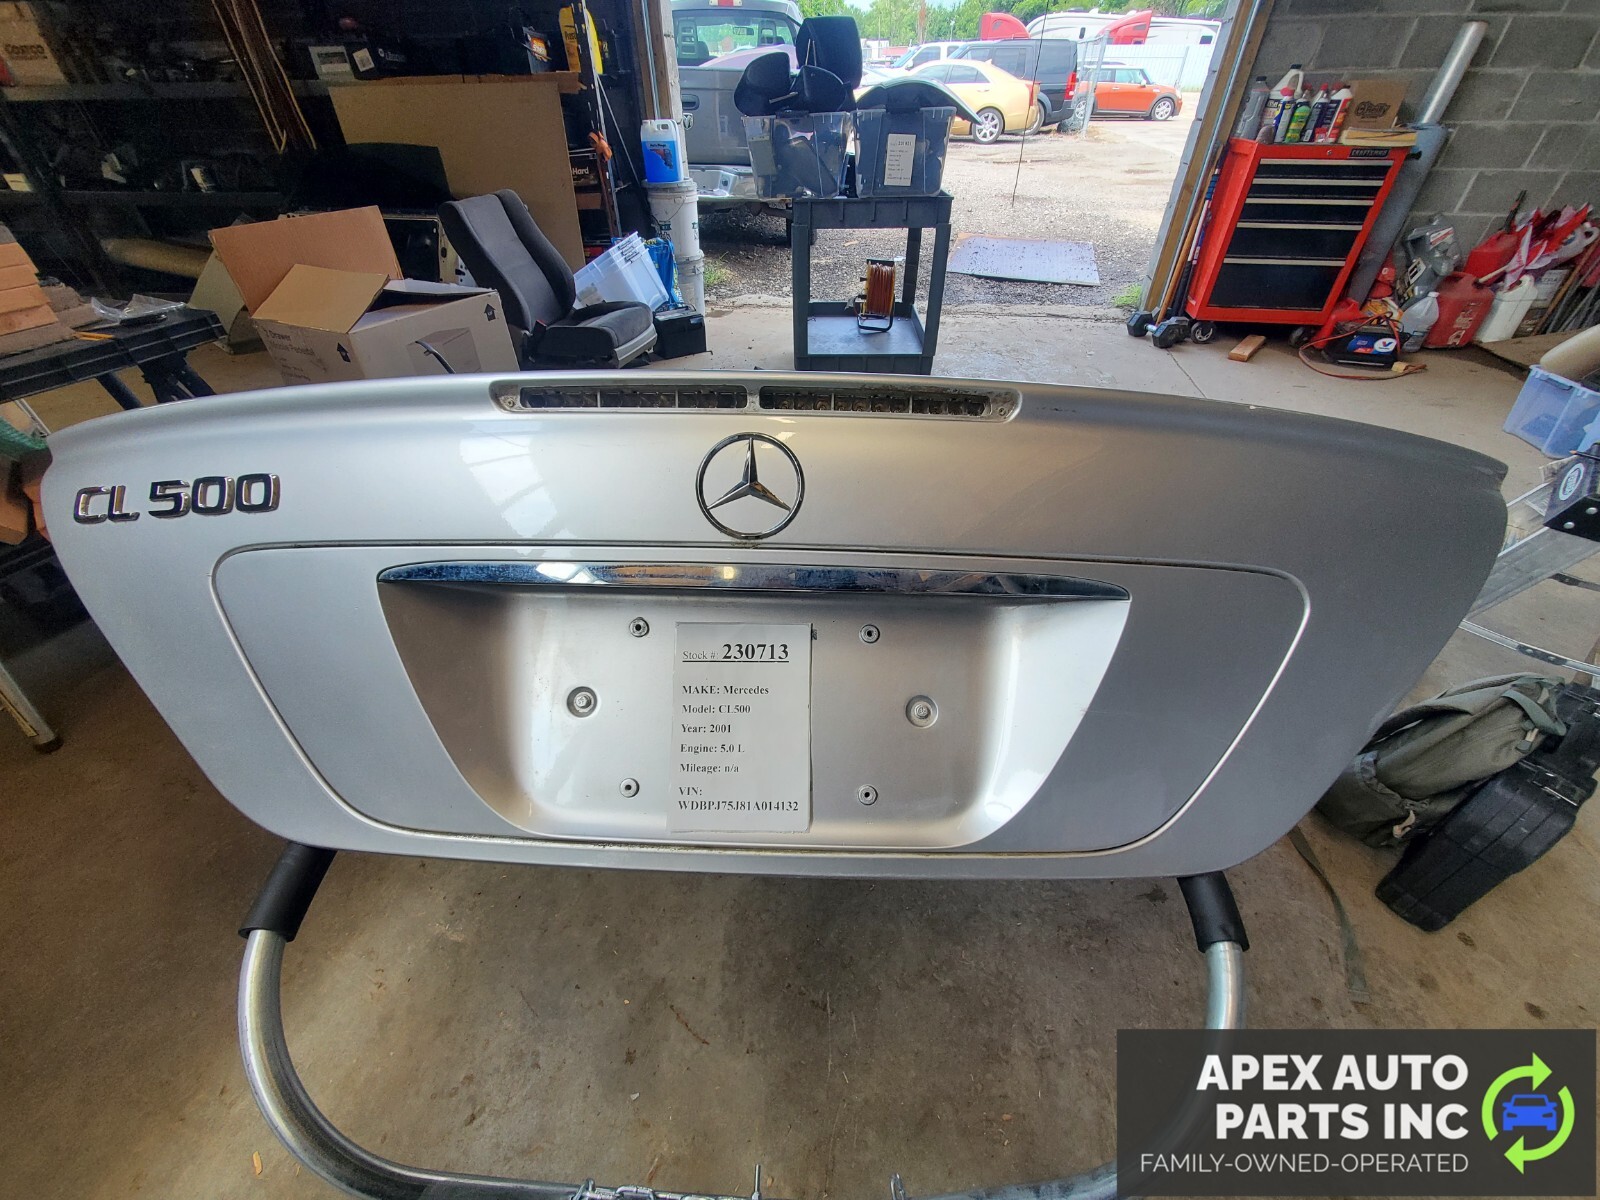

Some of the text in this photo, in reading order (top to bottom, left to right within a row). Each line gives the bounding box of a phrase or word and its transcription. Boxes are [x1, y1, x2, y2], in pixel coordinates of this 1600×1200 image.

[571, 166, 590, 176] Hard
[73, 473, 281, 525] CL 500
[682, 650, 708, 660] Stock
[722, 643, 789, 660] 230713
[682, 685, 769, 695] MAKE: Mercedes
[682, 704, 751, 714] Model: CL500
[681, 724, 732, 733] Year: 2001
[680, 744, 717, 754] Engine:
[720, 744, 734, 753] 5.0
[679, 763, 739, 774] Mileage: n/a
[679, 787, 702, 796] VIN:
[678, 801, 799, 811] WDBPJ75J81A014132
